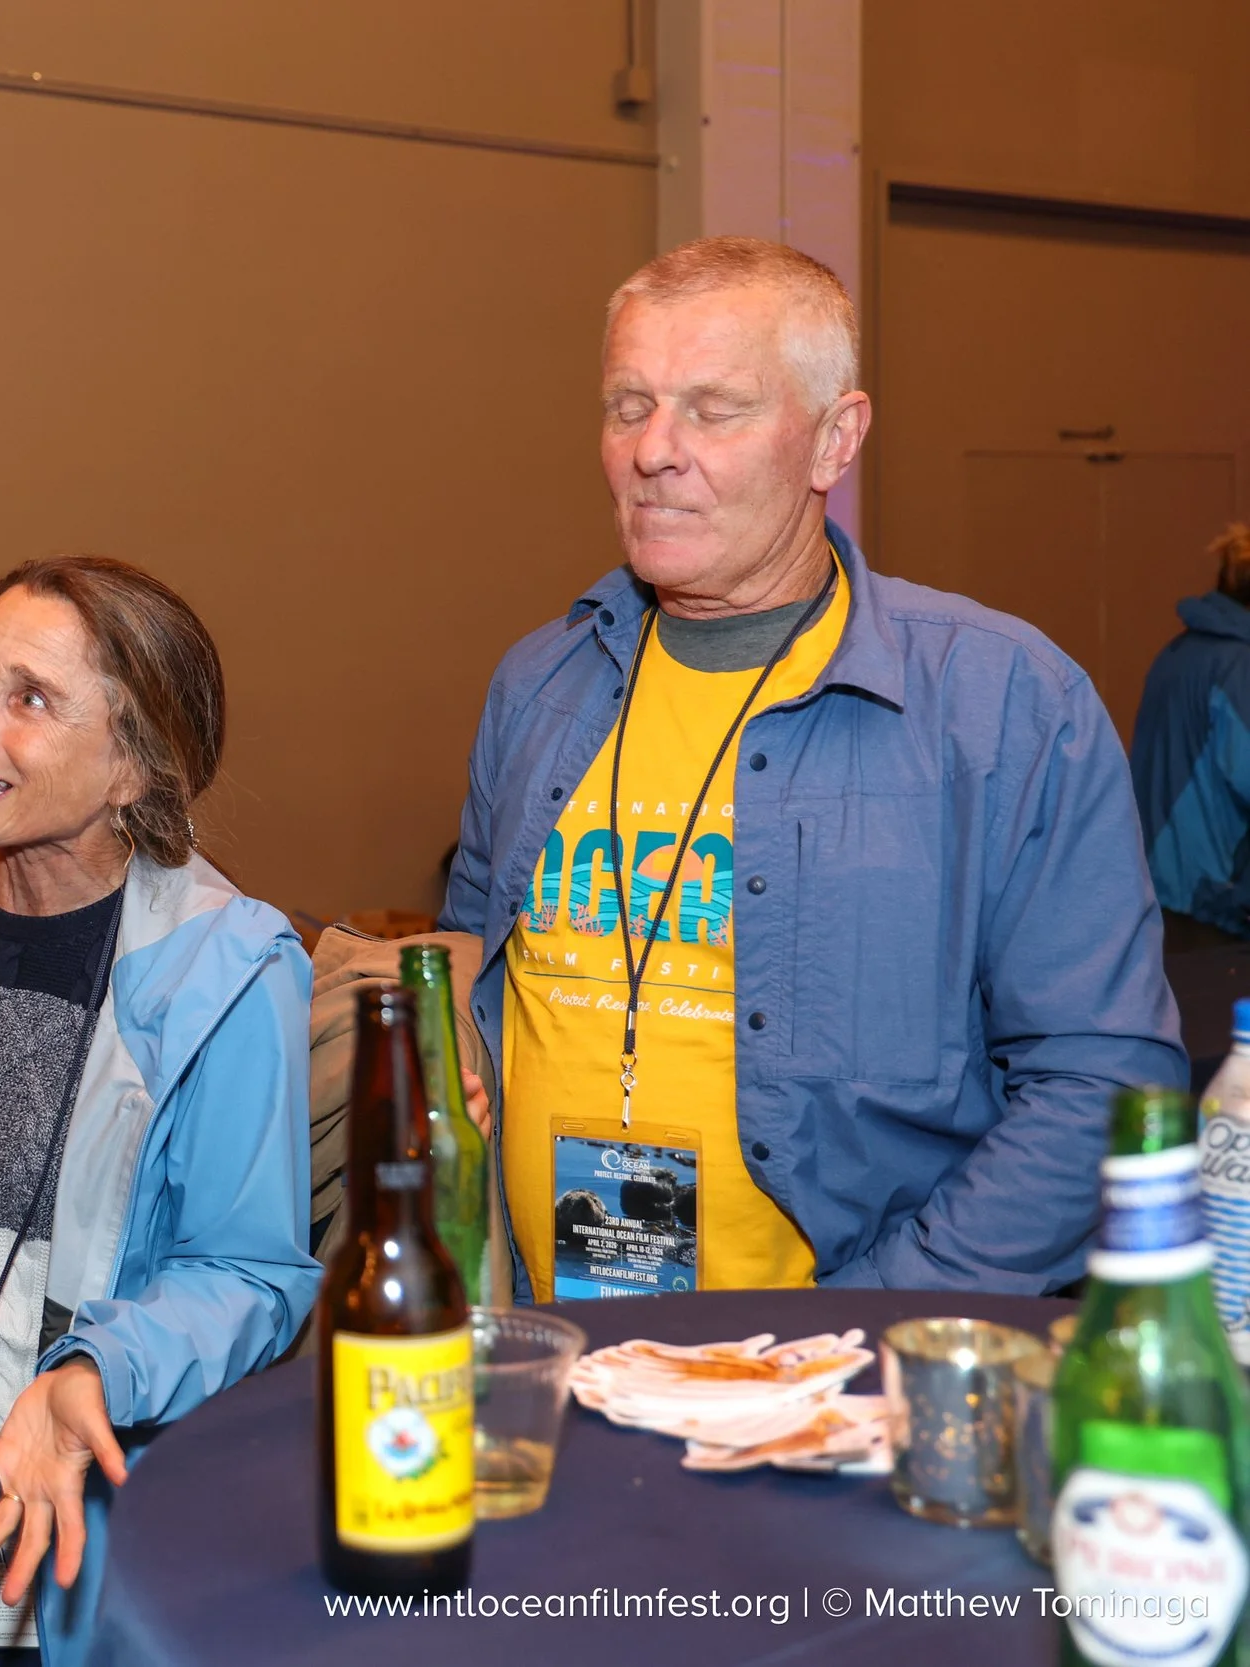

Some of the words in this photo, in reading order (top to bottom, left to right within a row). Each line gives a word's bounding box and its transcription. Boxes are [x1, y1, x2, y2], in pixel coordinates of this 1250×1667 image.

[523, 949, 577, 966] FILM
[549, 988, 590, 1008] Protect.
[621, 1160, 650, 1170] OCEAN
[605, 1215, 620, 1227] 23RD
[620, 1217, 643, 1229] ANNUAL
[572, 1224, 615, 1238] INTERNATIONAL
[616, 1229, 635, 1241] OCEAN
[635, 1232, 649, 1243] FILM
[650, 1234, 676, 1247] FESTIVAL
[587, 1238, 600, 1247] APRIL
[625, 1243, 638, 1252] APRIL
[590, 1265, 658, 1284] INTLOCEANFILMFEST.ORG
